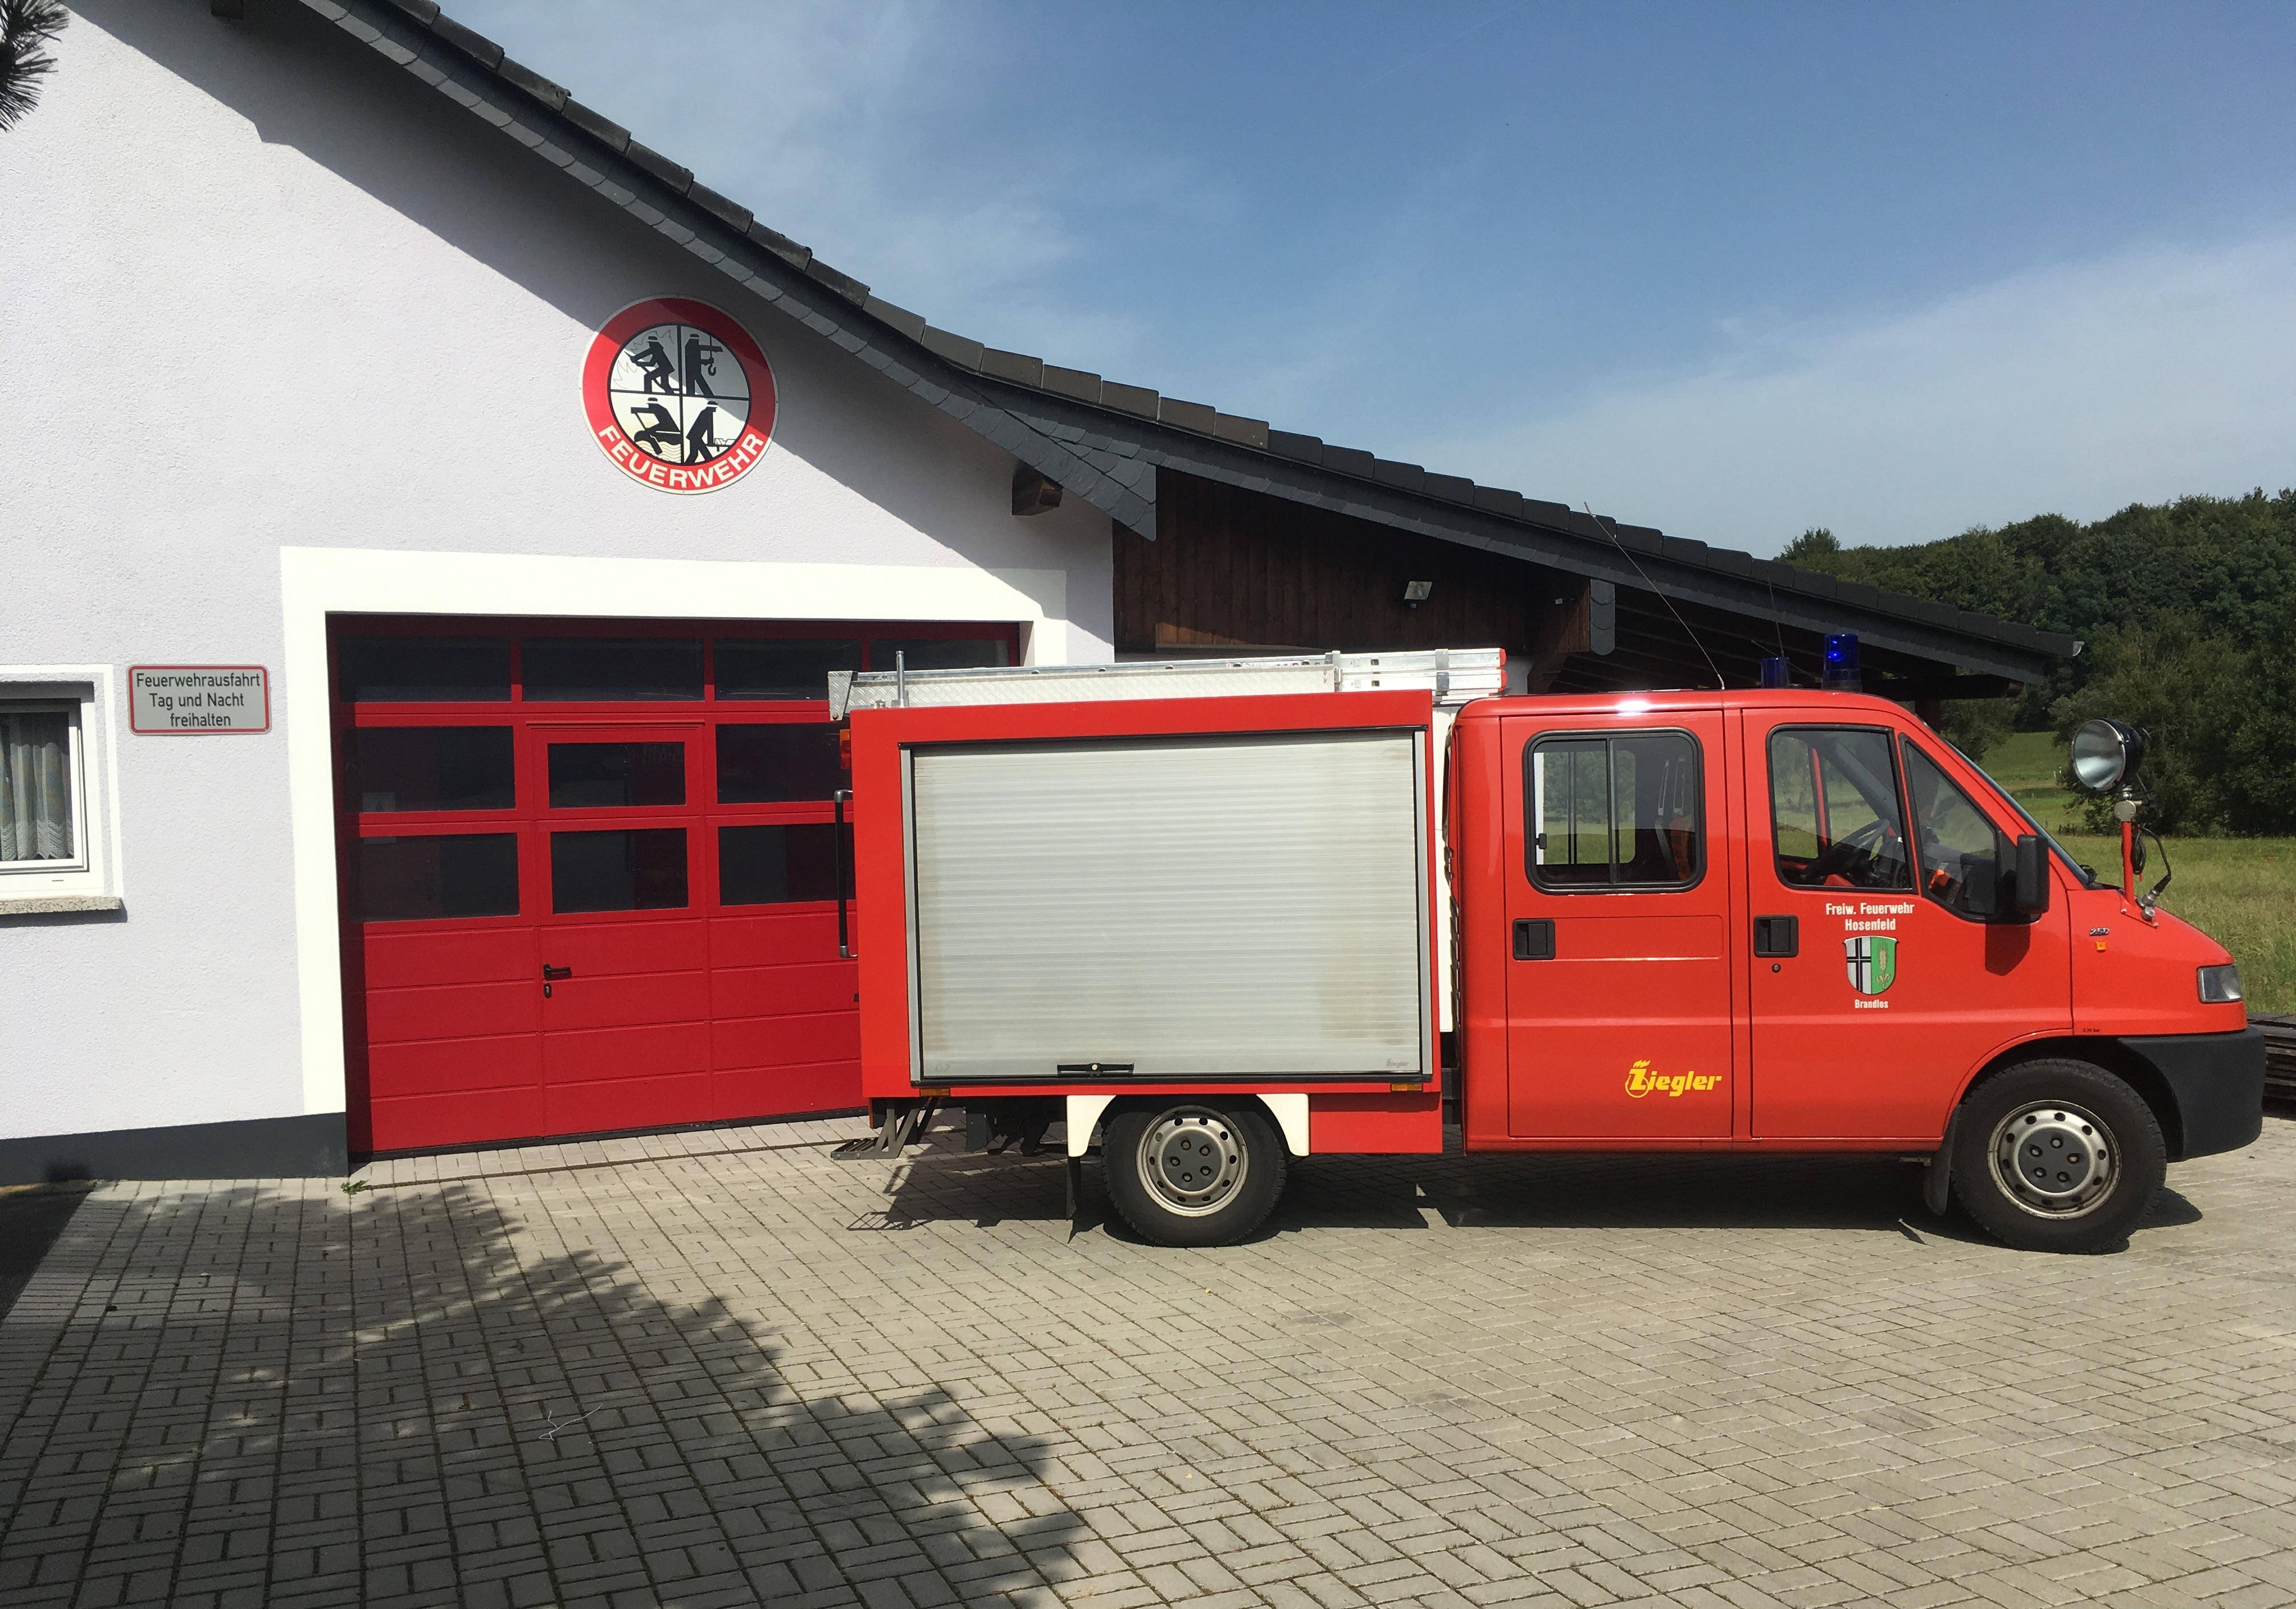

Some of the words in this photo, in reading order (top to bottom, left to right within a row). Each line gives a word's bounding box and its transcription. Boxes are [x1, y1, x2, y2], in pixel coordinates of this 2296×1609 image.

[598, 425, 764, 488] FEUERWEHR
[136, 672, 260, 687] Feuerwehrausfahrt
[149, 693, 173, 711] Tag
[178, 693, 202, 707] und
[207, 693, 244, 706] Nacht
[170, 713, 231, 726] freihalten
[1826, 903, 1856, 915] Freiw.
[1860, 902, 1914, 914] Feuerwehr
[1845, 918, 1896, 931] Hosenfeld
[1855, 999, 1889, 1008] Brandlos
[1626, 1066, 1722, 1097] Ziegler
